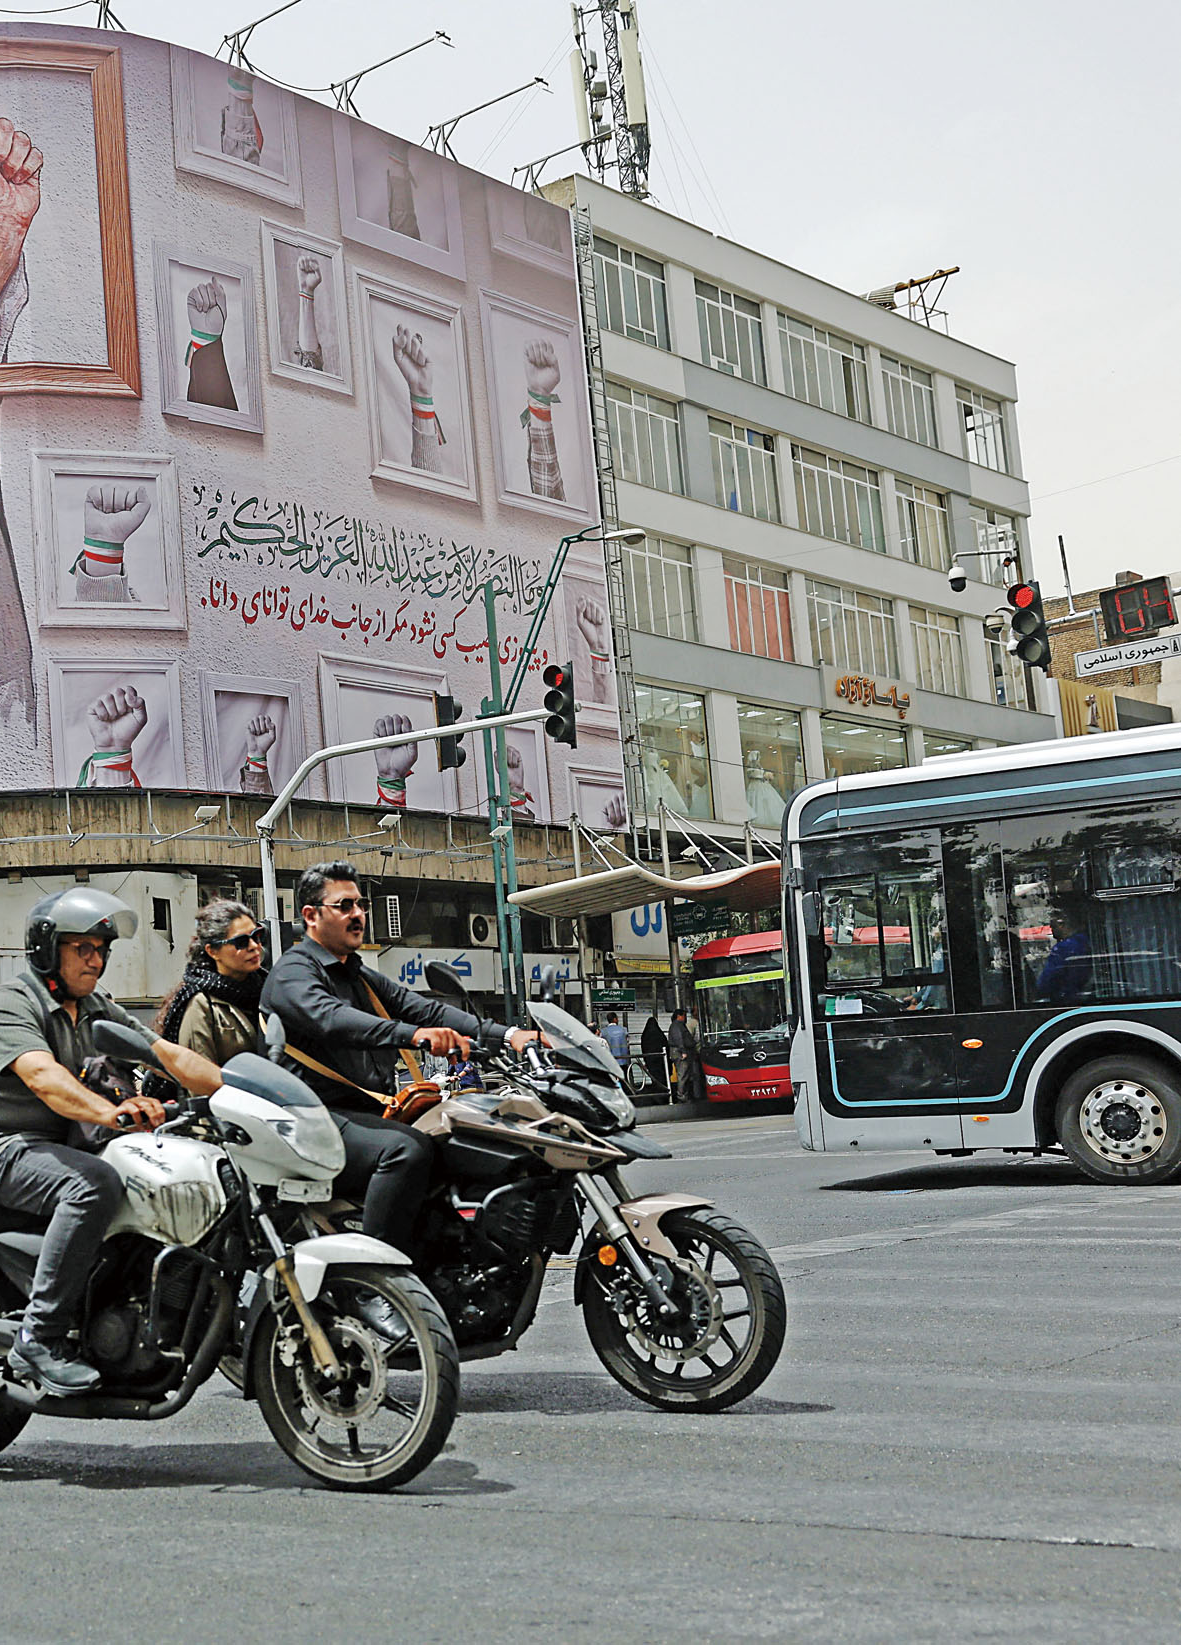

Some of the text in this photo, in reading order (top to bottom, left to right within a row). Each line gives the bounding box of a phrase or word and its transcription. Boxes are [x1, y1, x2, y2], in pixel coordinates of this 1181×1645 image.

[241, 585, 290, 625] توانای
[290, 592, 330, 631] خدای
[331, 602, 373, 647] جانب
[372, 608, 386, 637] از
[385, 599, 410, 642] مگر
[410, 611, 436, 644] نشود
[432, 605, 467, 659] کسی
[1083, 642, 1169, 669] جمهوری اسلامی
[398, 952, 422, 985] نور
